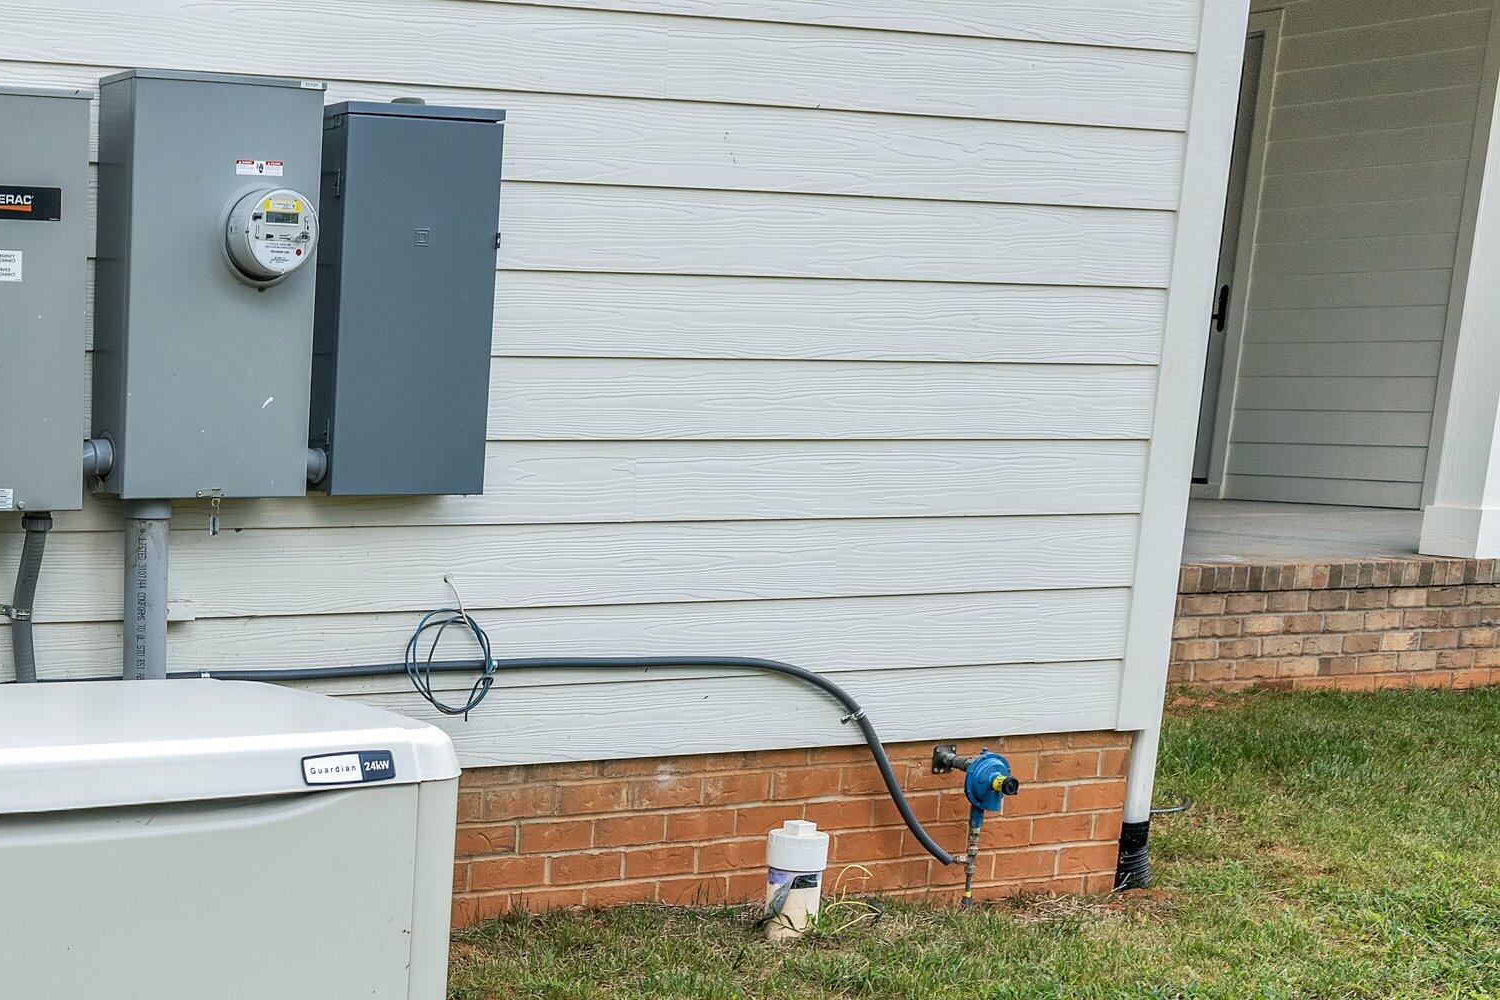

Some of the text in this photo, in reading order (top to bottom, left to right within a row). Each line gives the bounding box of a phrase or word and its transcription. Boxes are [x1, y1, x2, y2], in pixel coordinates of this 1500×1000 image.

[137, 537, 147, 561] LISTED
[310, 760, 390, 774] Guardian 24kW
